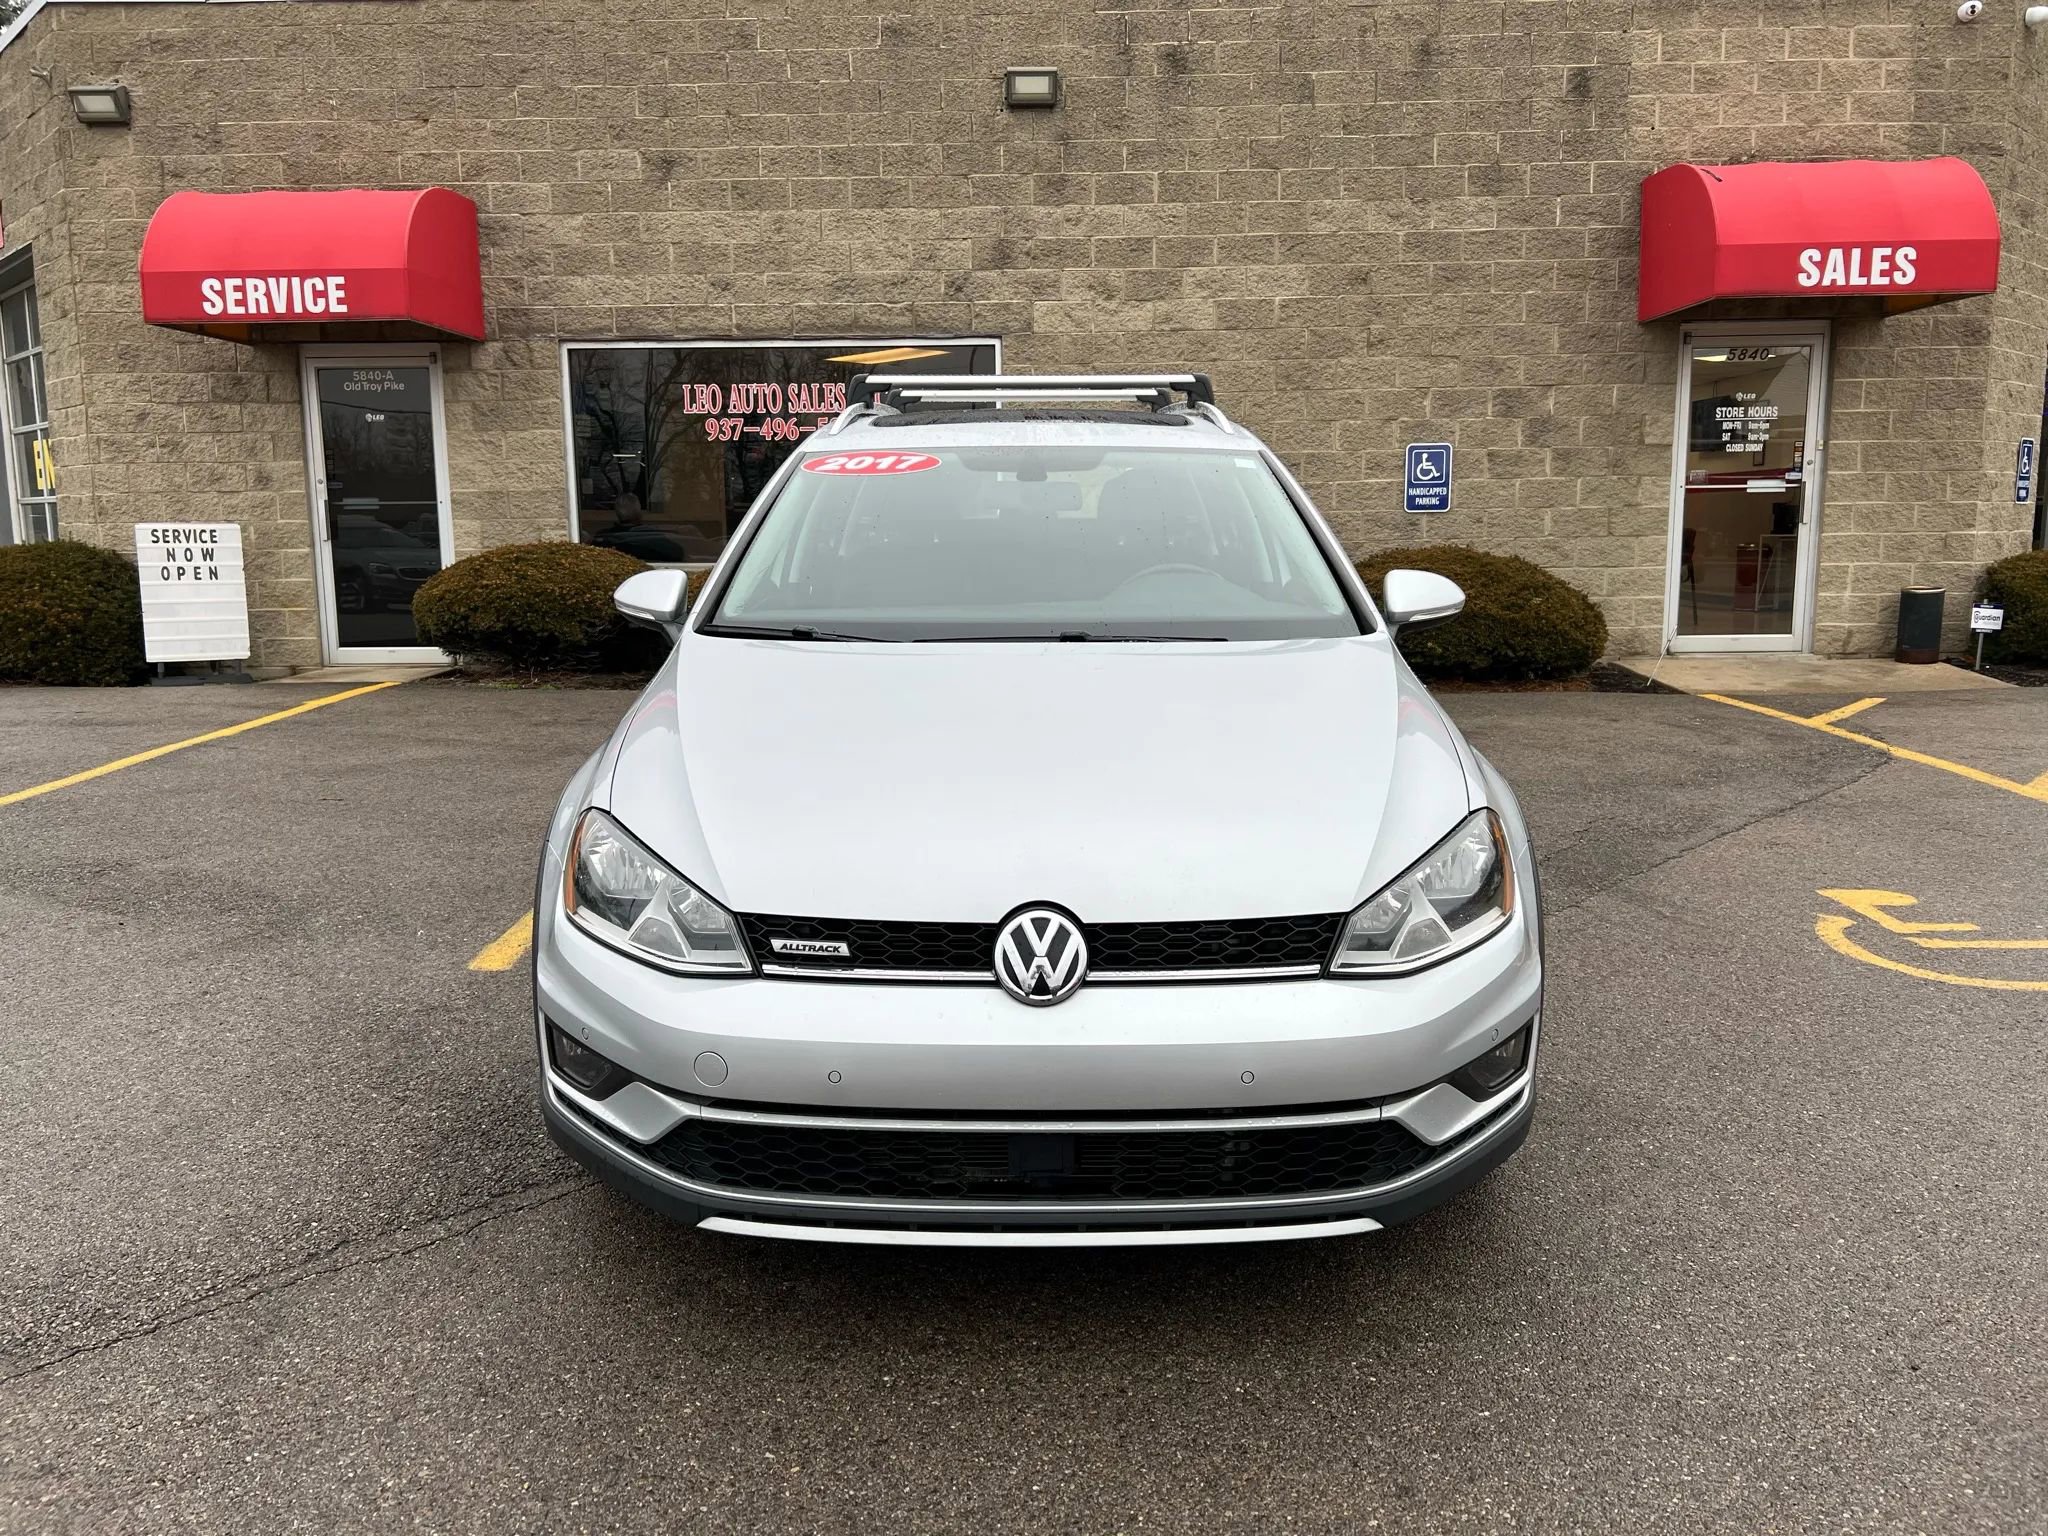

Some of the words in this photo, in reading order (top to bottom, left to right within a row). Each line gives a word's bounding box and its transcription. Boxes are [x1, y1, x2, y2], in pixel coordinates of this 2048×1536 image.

[1797, 246, 1917, 287] SALES
[201, 276, 348, 315] SERVICE
[1727, 348, 1770, 361] 5840
[353, 370, 394, 381] 5840-A
[343, 382, 361, 391] Old
[362, 382, 382, 392] Troy
[384, 381, 405, 391] Pike
[682, 383, 723, 414] LEO
[728, 383, 783, 414] AUTO
[787, 383, 847, 414] SALES
[1715, 406, 1745, 418] STORE
[1748, 406, 1778, 417] HOURS
[1722, 432, 1731, 441] SAT
[1725, 443, 1744, 452] CLOSED
[1745, 443, 1764, 452] SUNDAY
[814, 455, 929, 471] 2017
[1408, 487, 1447, 496] HANDICAPPED
[1415, 497, 1440, 505] PARKING
[151, 528, 218, 544] SERVICE
[166, 547, 214, 562] NOW
[161, 566, 219, 581] OPEN
[779, 943, 841, 954] ALLTRACK
